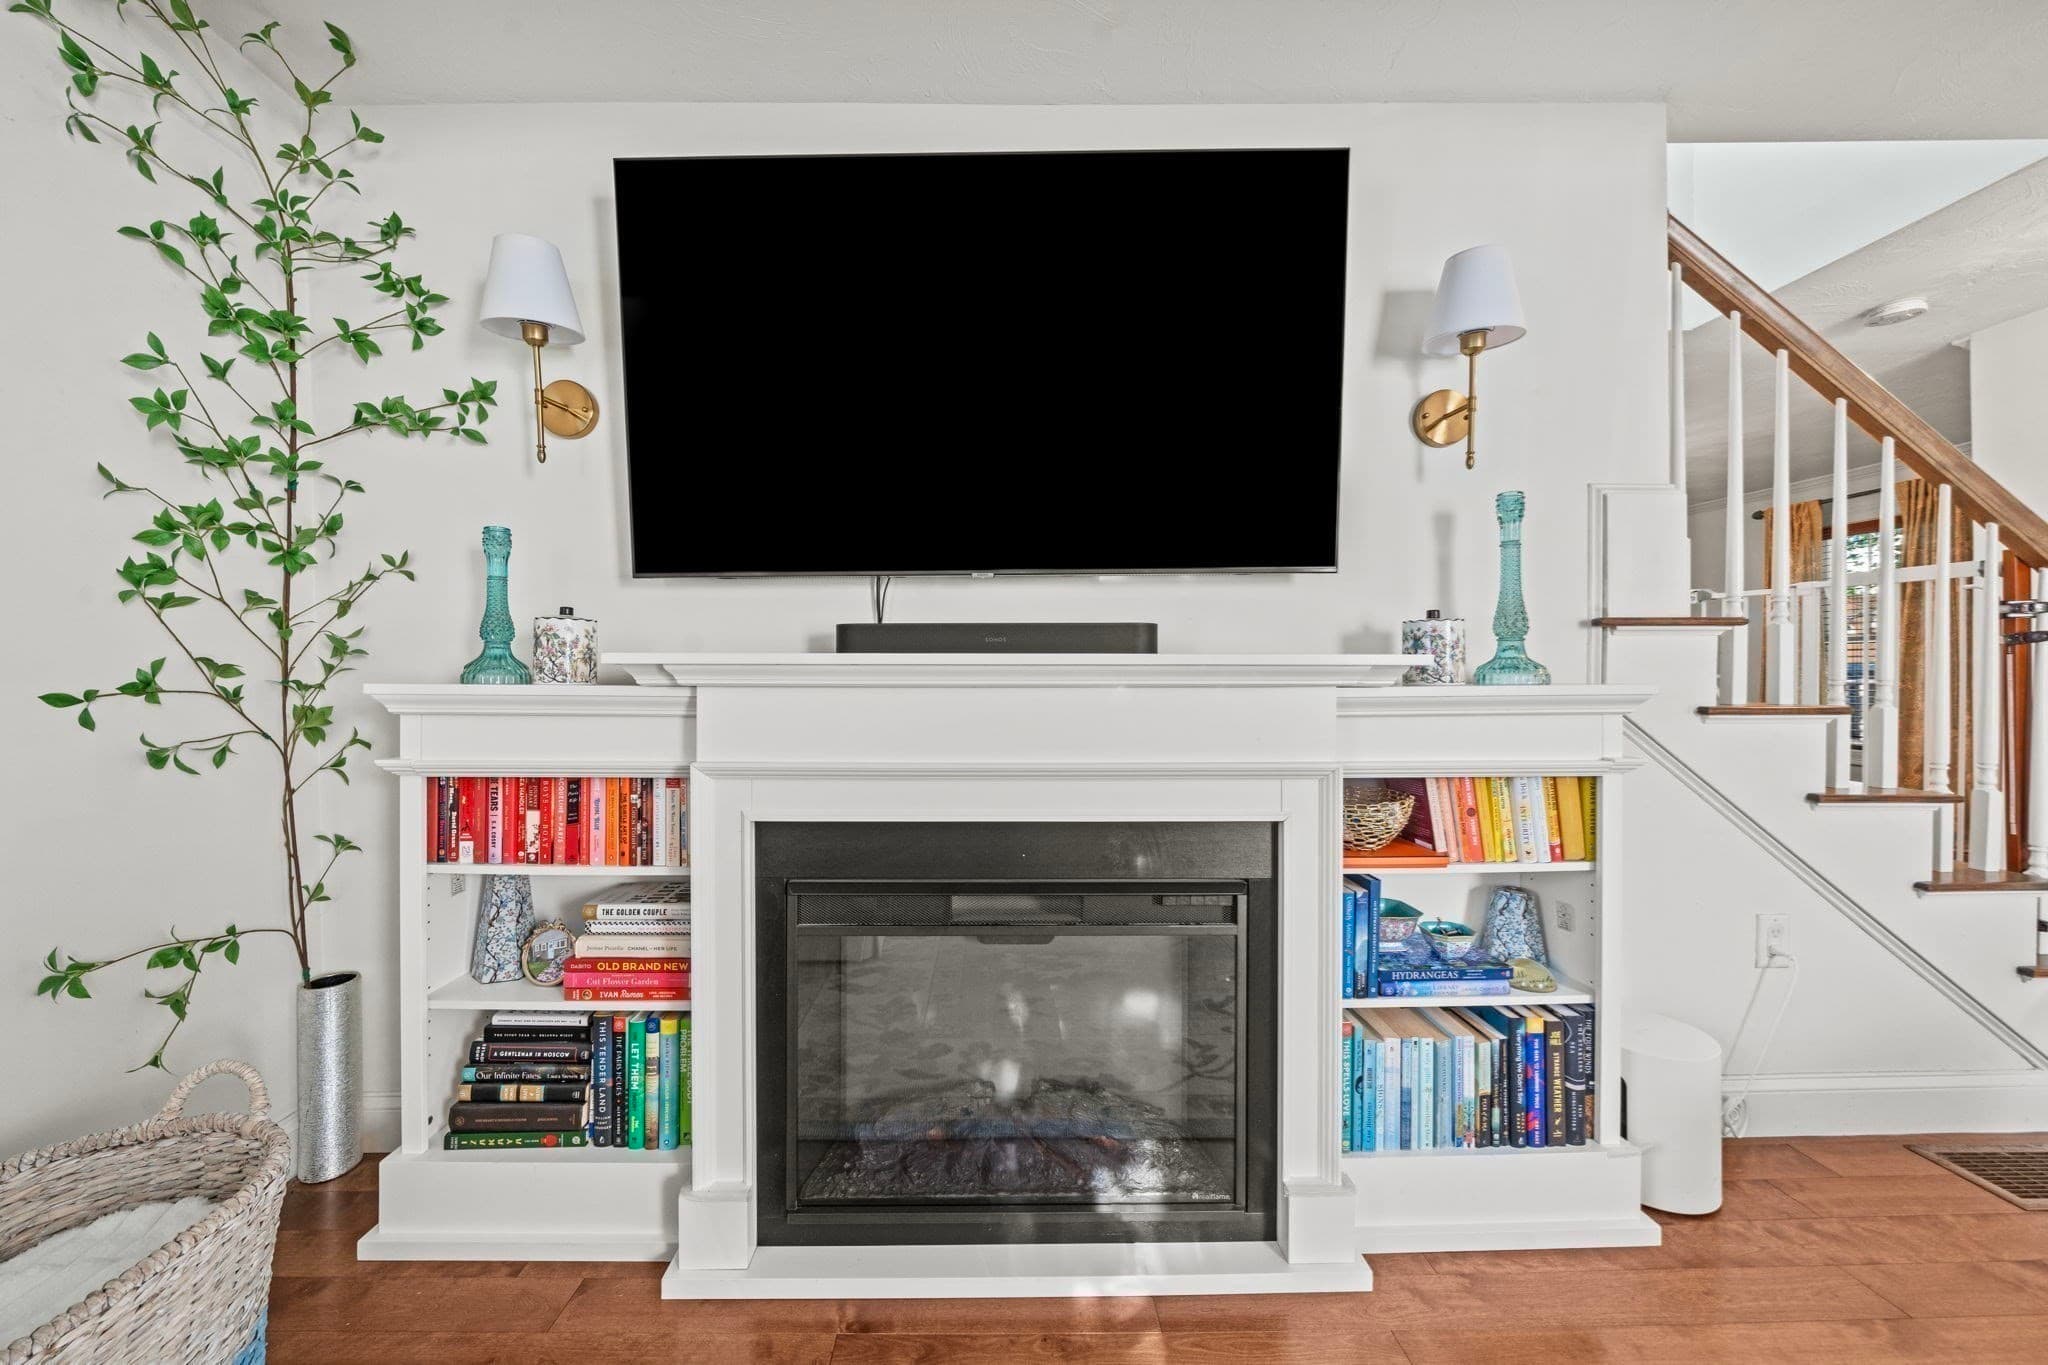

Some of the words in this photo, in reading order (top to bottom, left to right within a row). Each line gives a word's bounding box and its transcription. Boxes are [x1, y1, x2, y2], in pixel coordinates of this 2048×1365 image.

[490, 787, 499, 812] TEARS
[602, 908, 613, 916] THE
[616, 908, 641, 916] GOLDEN
[642, 908, 668, 916] COUPLE
[597, 962, 620, 971] OLD
[622, 962, 661, 971] BRAND
[664, 962, 689, 971] NEW
[586, 977, 601, 986] Cut
[602, 976, 629, 986] Flower
[631, 976, 659, 986] Garden
[1392, 971, 1459, 981] HYDRANGEAS
[631, 1043, 640, 1060] LET
[1516, 1063, 1523, 1073] We
[476, 1071, 493, 1080] Our
[494, 1070, 520, 1079] Infinite
[522, 1071, 541, 1080] Fates
[631, 1063, 640, 1090] THEM
[1553, 1079, 1562, 1113] WEATHER
